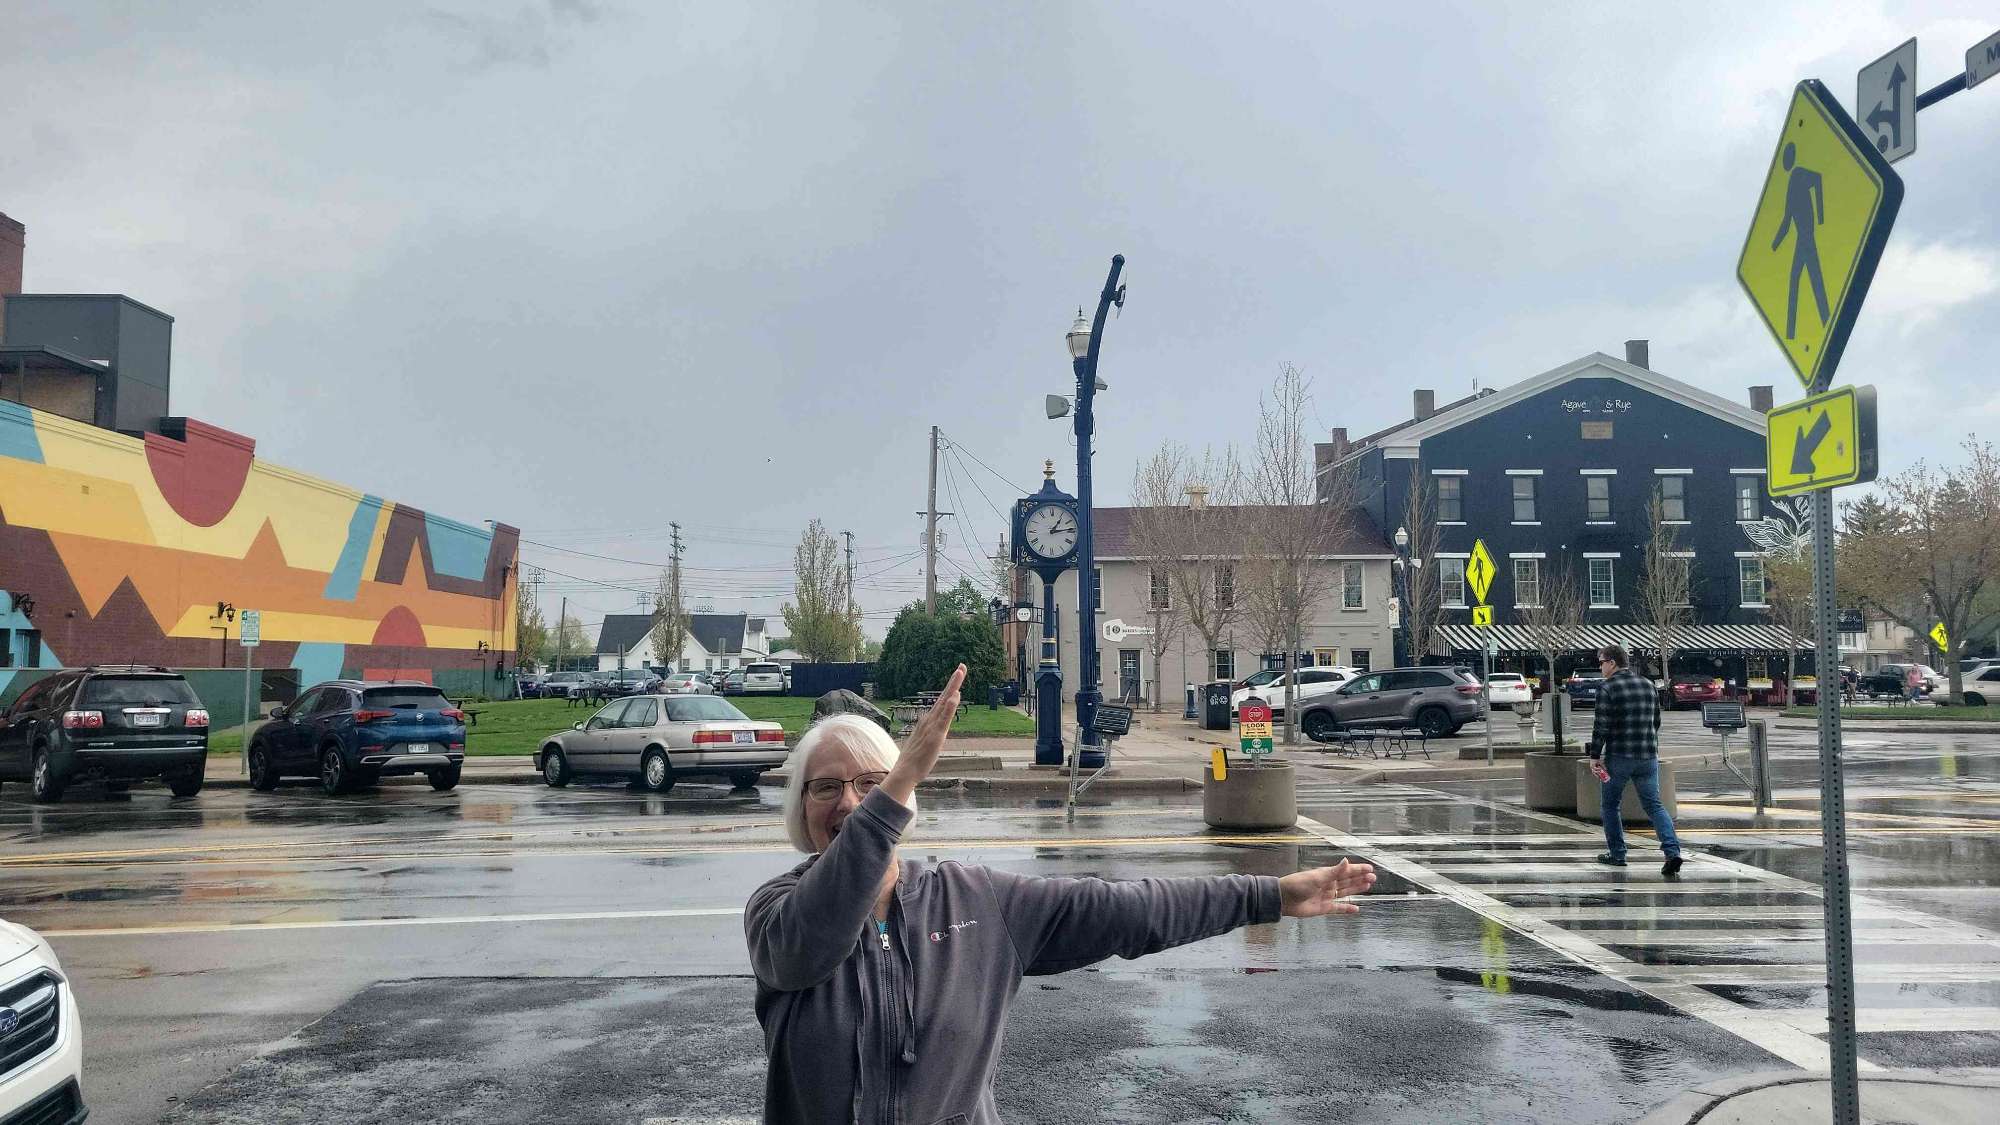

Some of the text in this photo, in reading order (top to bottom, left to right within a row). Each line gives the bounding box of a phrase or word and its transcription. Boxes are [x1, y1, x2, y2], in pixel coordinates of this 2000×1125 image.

[1560, 400, 1631, 412] Agave & Rye
